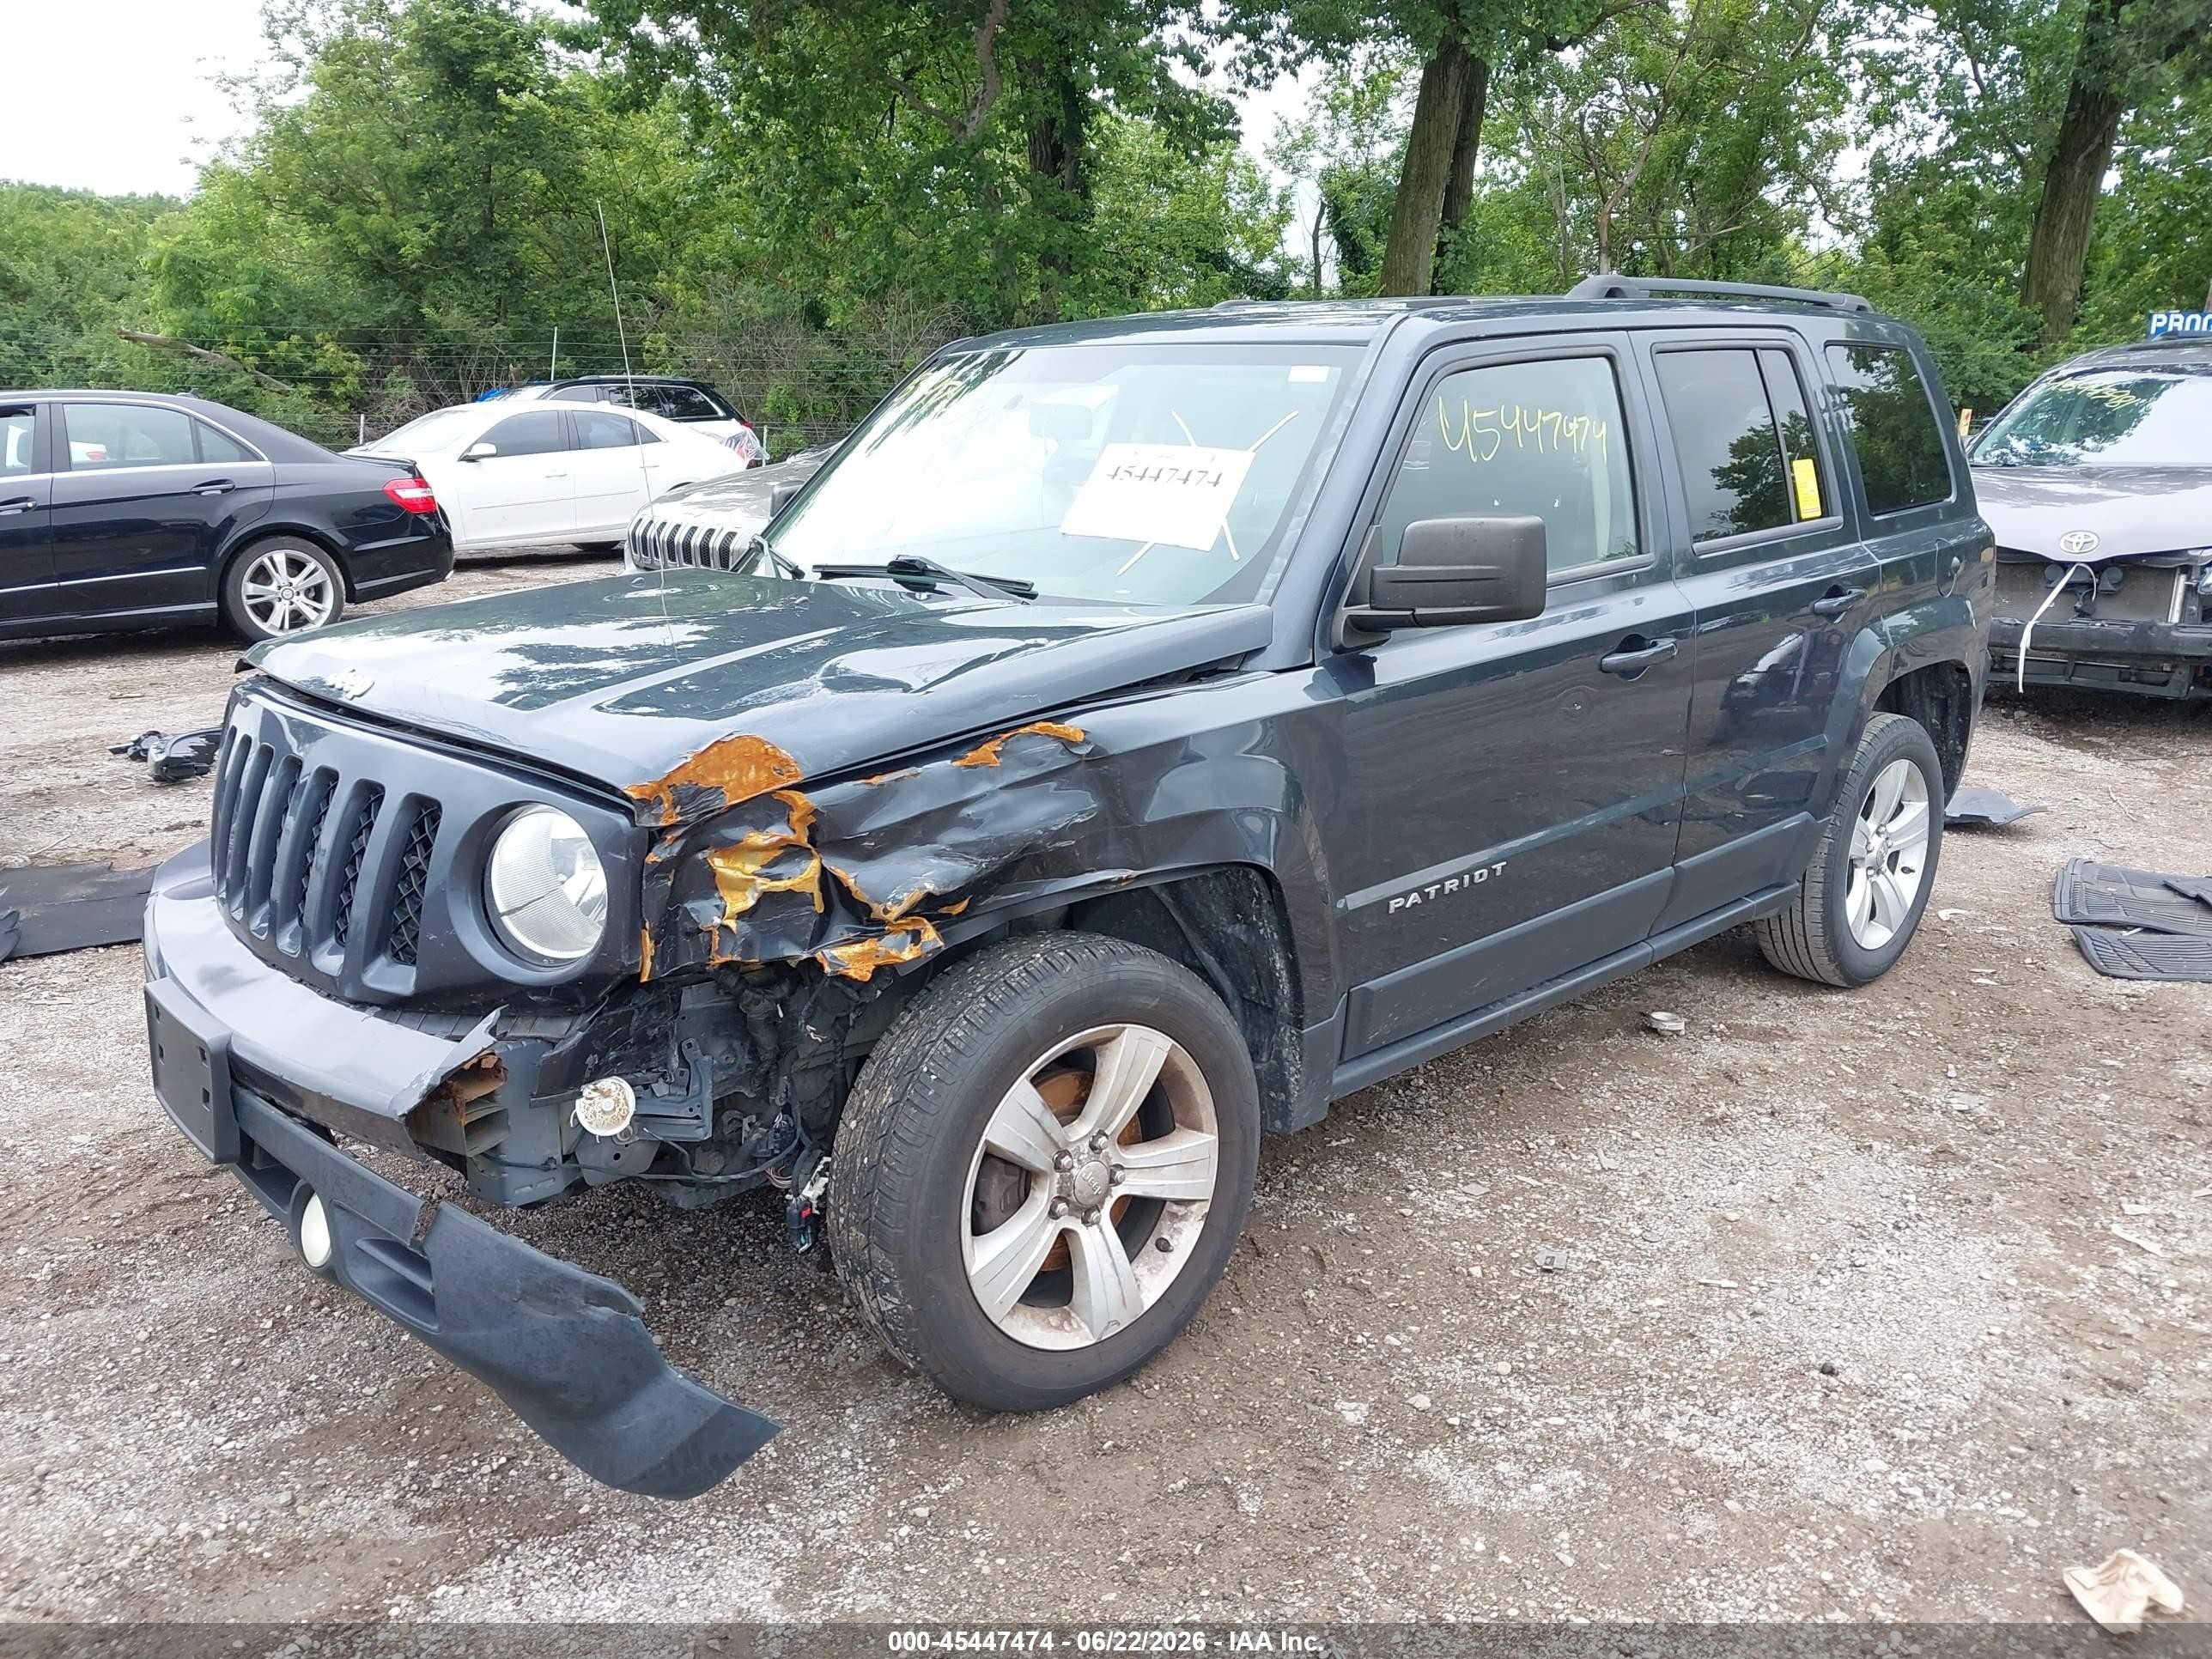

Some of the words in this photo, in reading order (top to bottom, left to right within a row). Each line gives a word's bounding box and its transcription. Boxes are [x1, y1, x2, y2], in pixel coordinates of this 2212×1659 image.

[1437, 396, 1608, 464] 45447474
[1106, 465, 1223, 488] 45447474
[1388, 861, 1508, 915] PATRIOT
